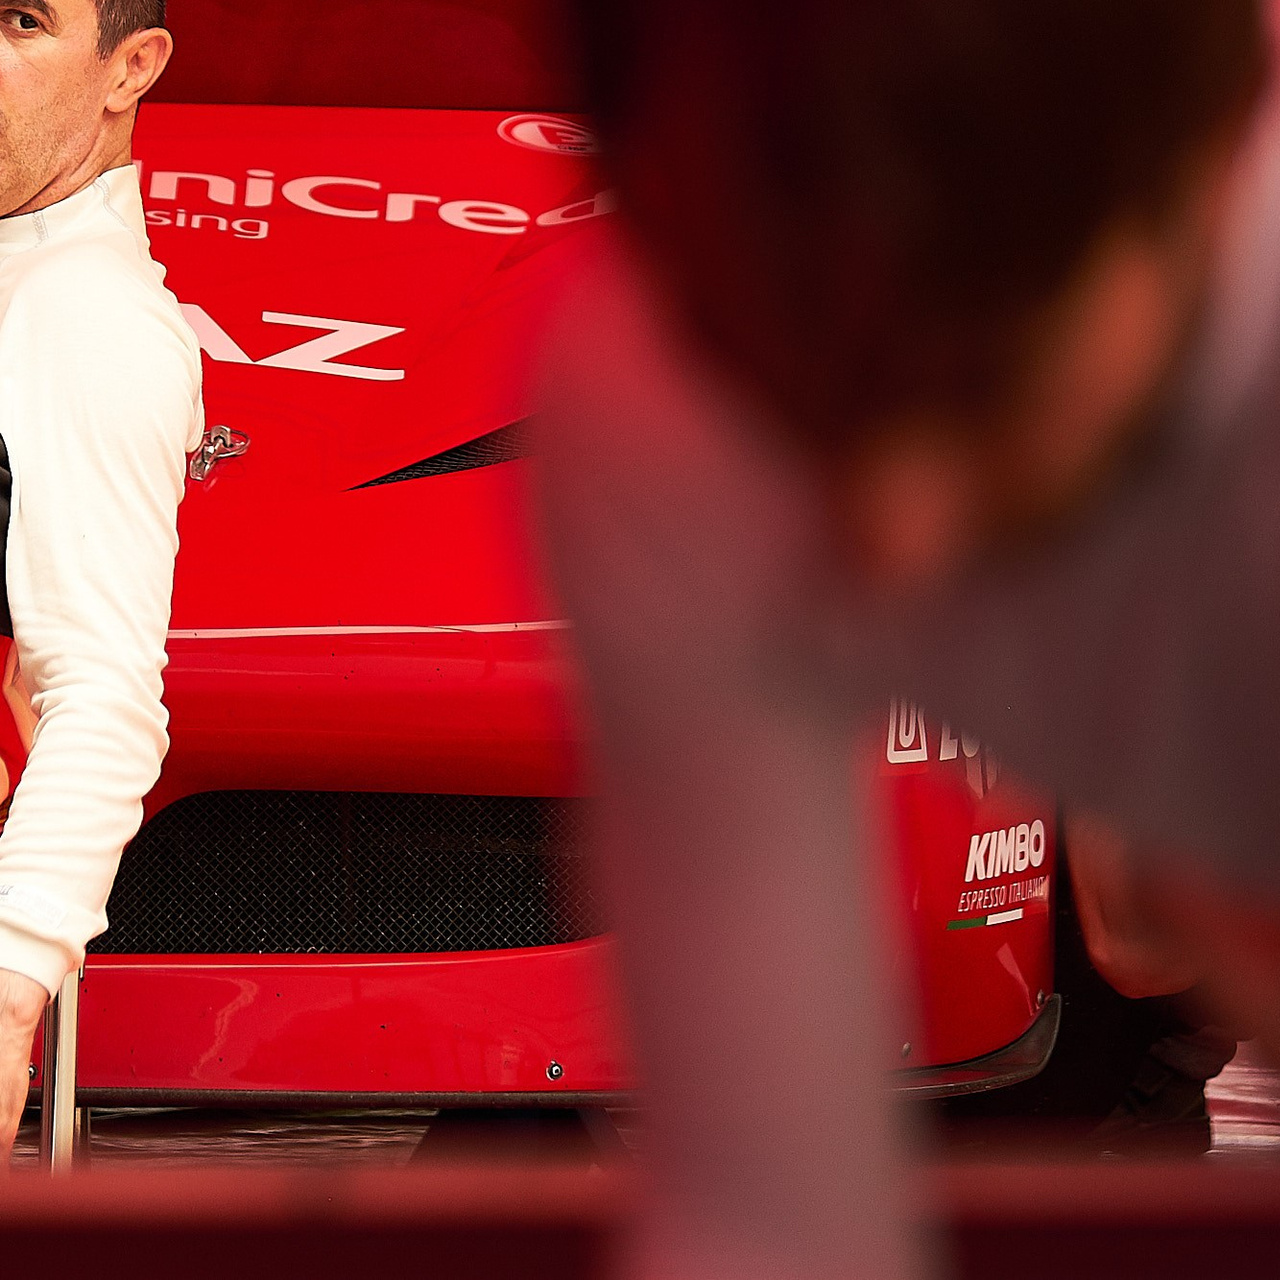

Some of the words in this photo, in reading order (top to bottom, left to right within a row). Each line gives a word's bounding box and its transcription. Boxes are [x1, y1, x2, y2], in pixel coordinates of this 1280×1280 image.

[132, 160, 617, 235] niCred
[145, 208, 269, 240] sing
[964, 819, 1045, 882] KIMBO
[957, 885, 1008, 912] ESPRESSO
